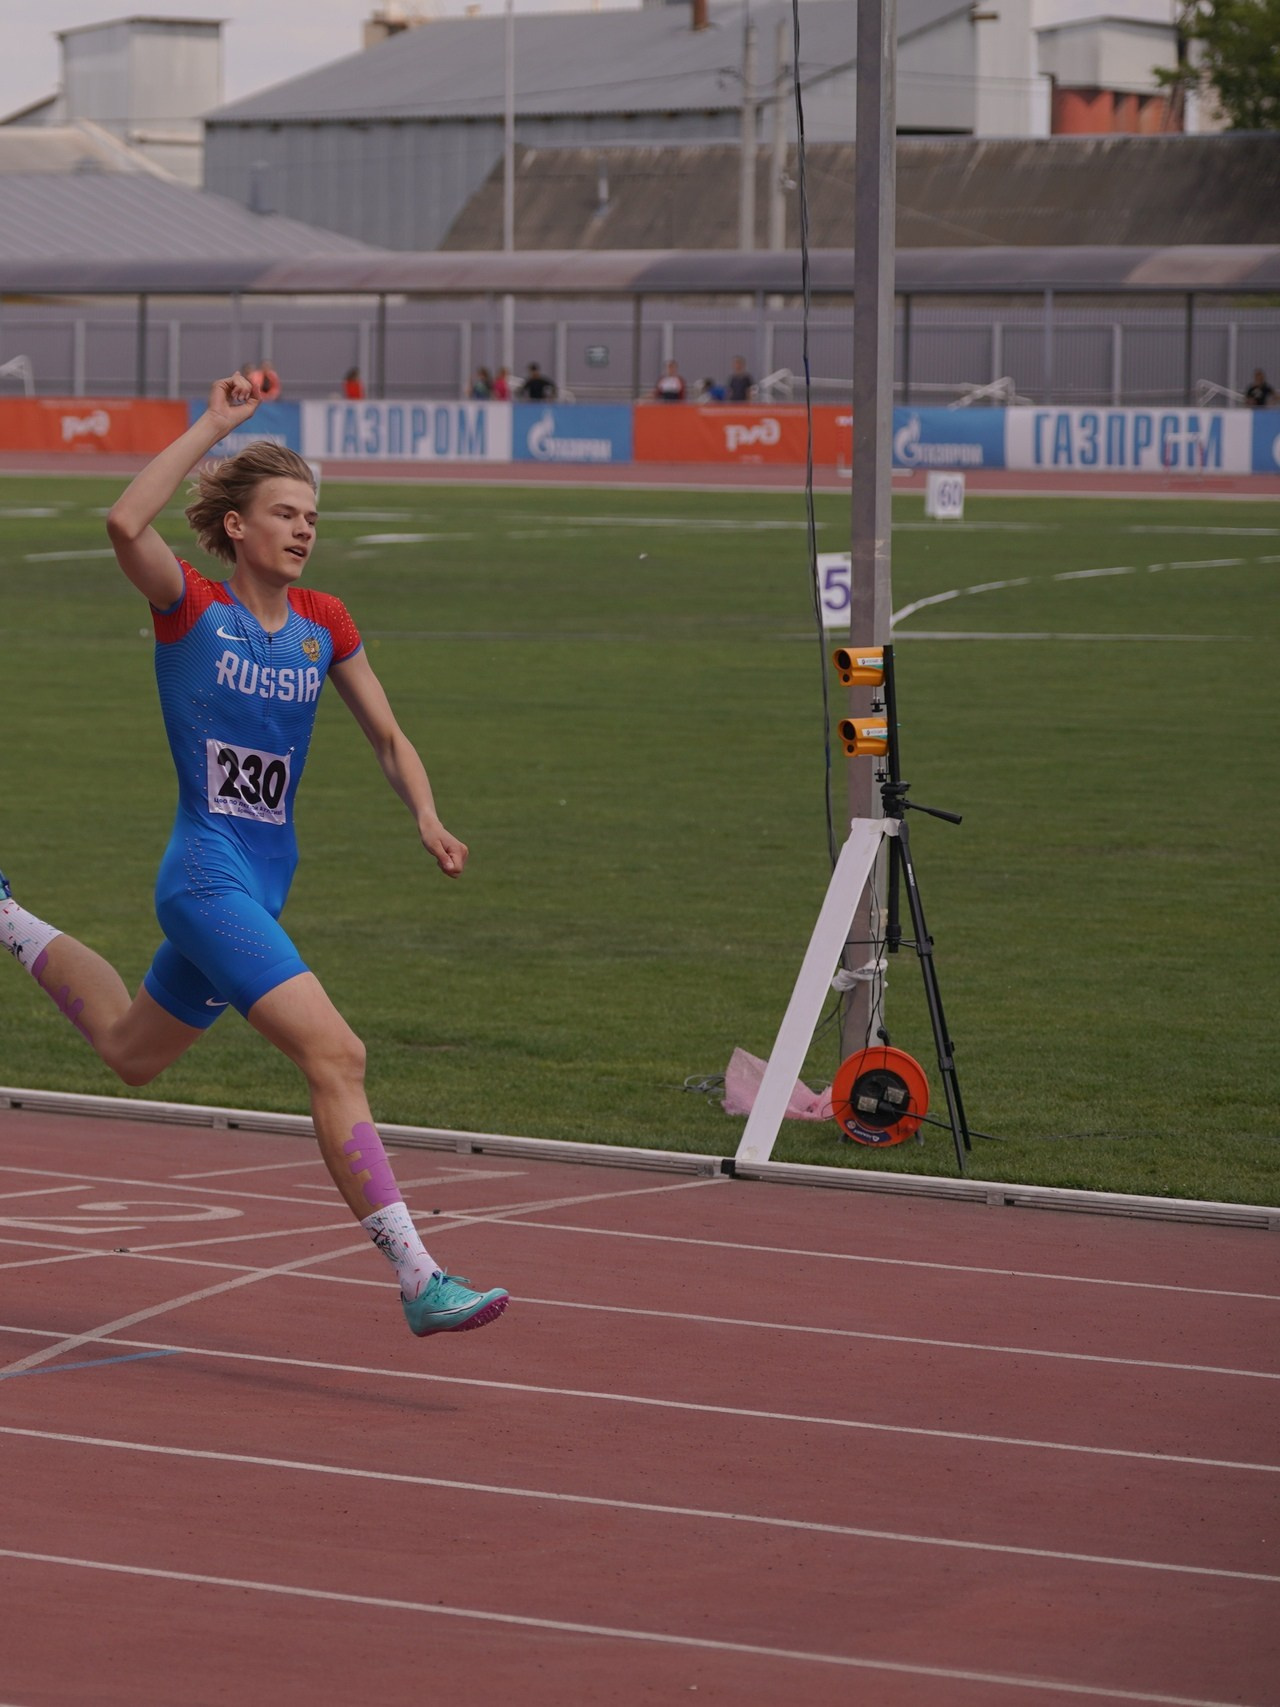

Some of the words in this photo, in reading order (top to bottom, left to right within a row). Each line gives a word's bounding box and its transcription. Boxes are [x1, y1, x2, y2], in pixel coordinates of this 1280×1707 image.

[326, 405, 486, 456] ГАЗПРОМ
[1033, 412, 1223, 468] ГАЗПРОМ
[824, 566, 851, 610] 5
[215, 650, 320, 702] RUSSIA
[217, 748, 286, 809] 230
